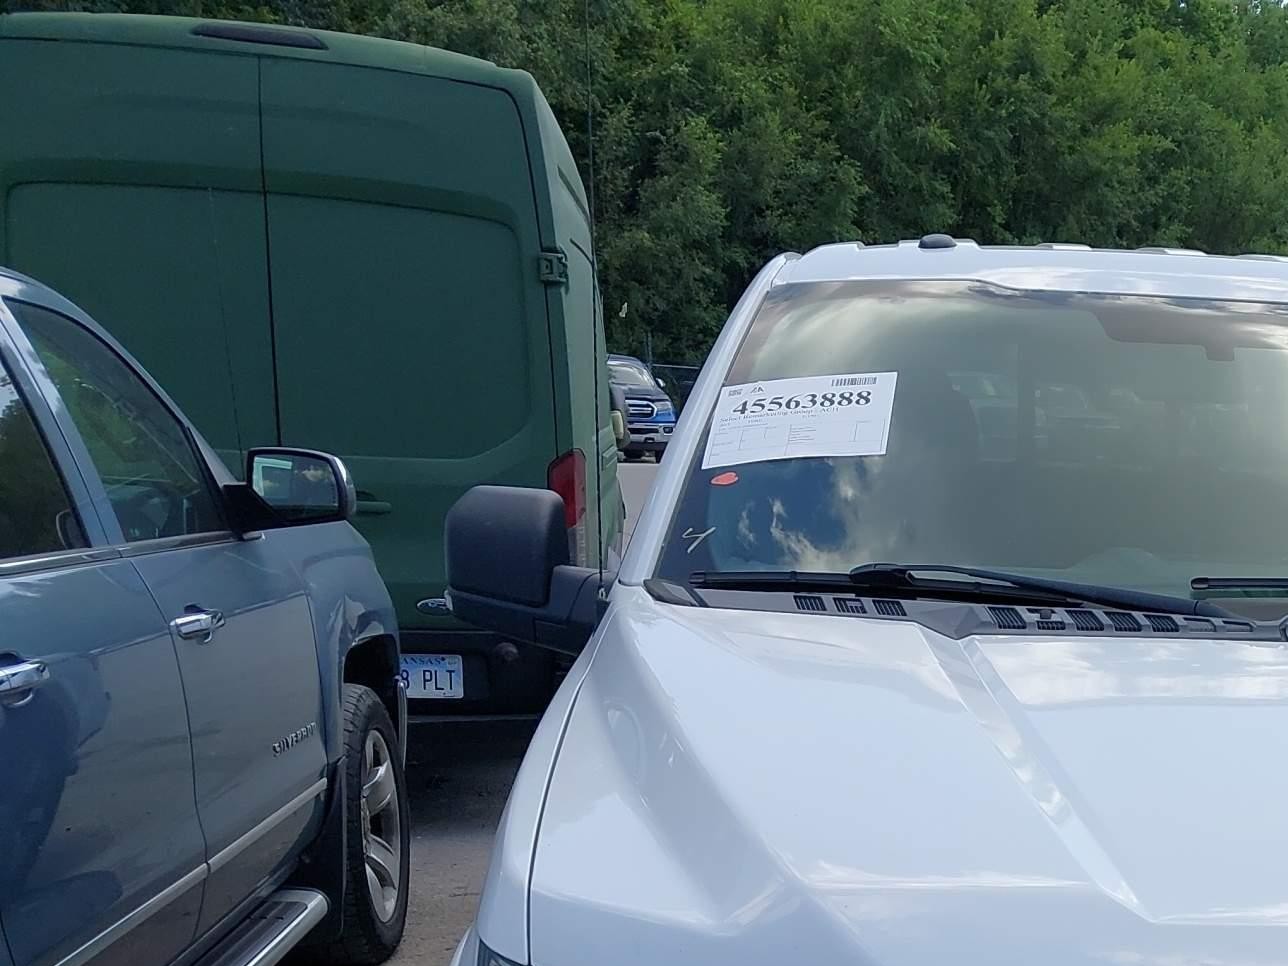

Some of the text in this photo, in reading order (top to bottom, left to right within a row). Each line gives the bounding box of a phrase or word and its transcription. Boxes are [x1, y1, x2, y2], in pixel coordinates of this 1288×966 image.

[732, 390, 872, 415] 45563888
[400, 656, 442, 665] ANSAS
[422, 669, 456, 691] PLT
